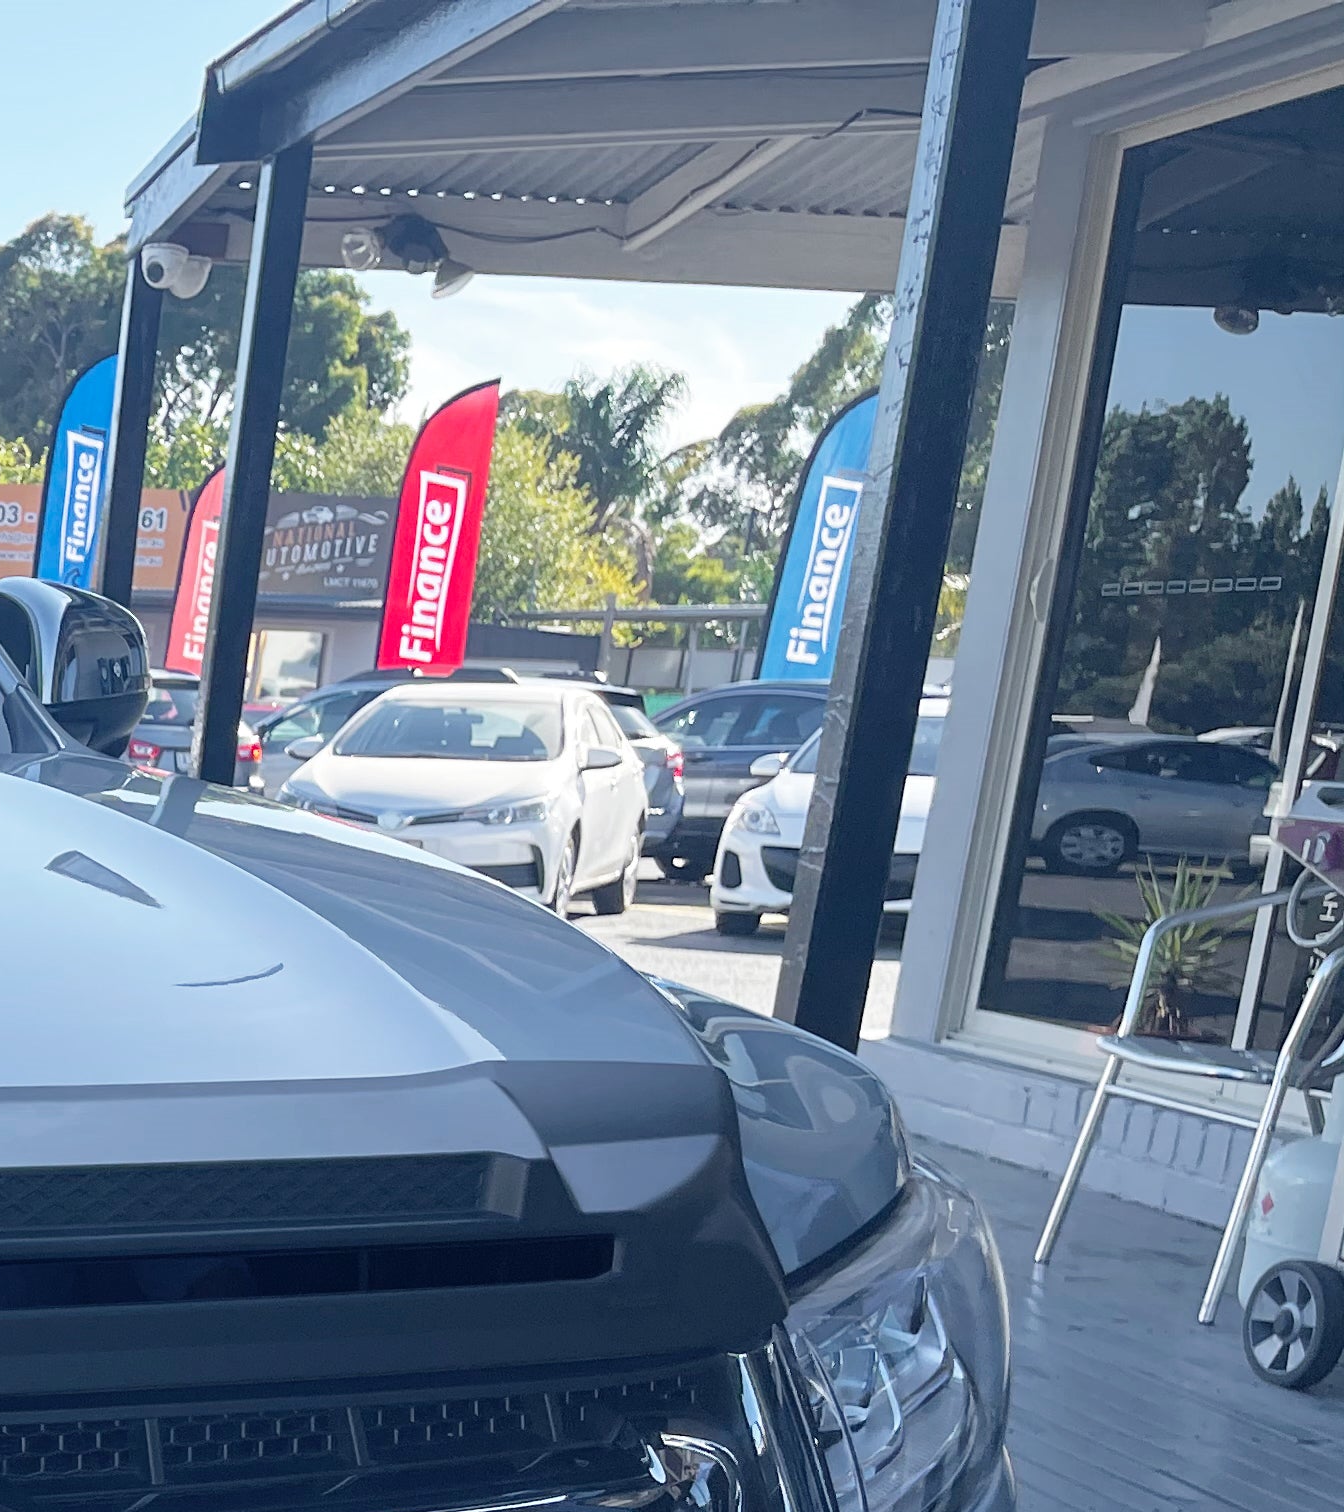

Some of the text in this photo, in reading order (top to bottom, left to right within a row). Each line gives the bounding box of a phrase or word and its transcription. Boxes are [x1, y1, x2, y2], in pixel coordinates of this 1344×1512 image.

[65, 451, 95, 563] Finance
[265, 533, 379, 567] UTOMOTIVE
[272, 521, 355, 547] NATIONAL
[399, 500, 452, 663] Finance
[786, 503, 851, 665] Finance
